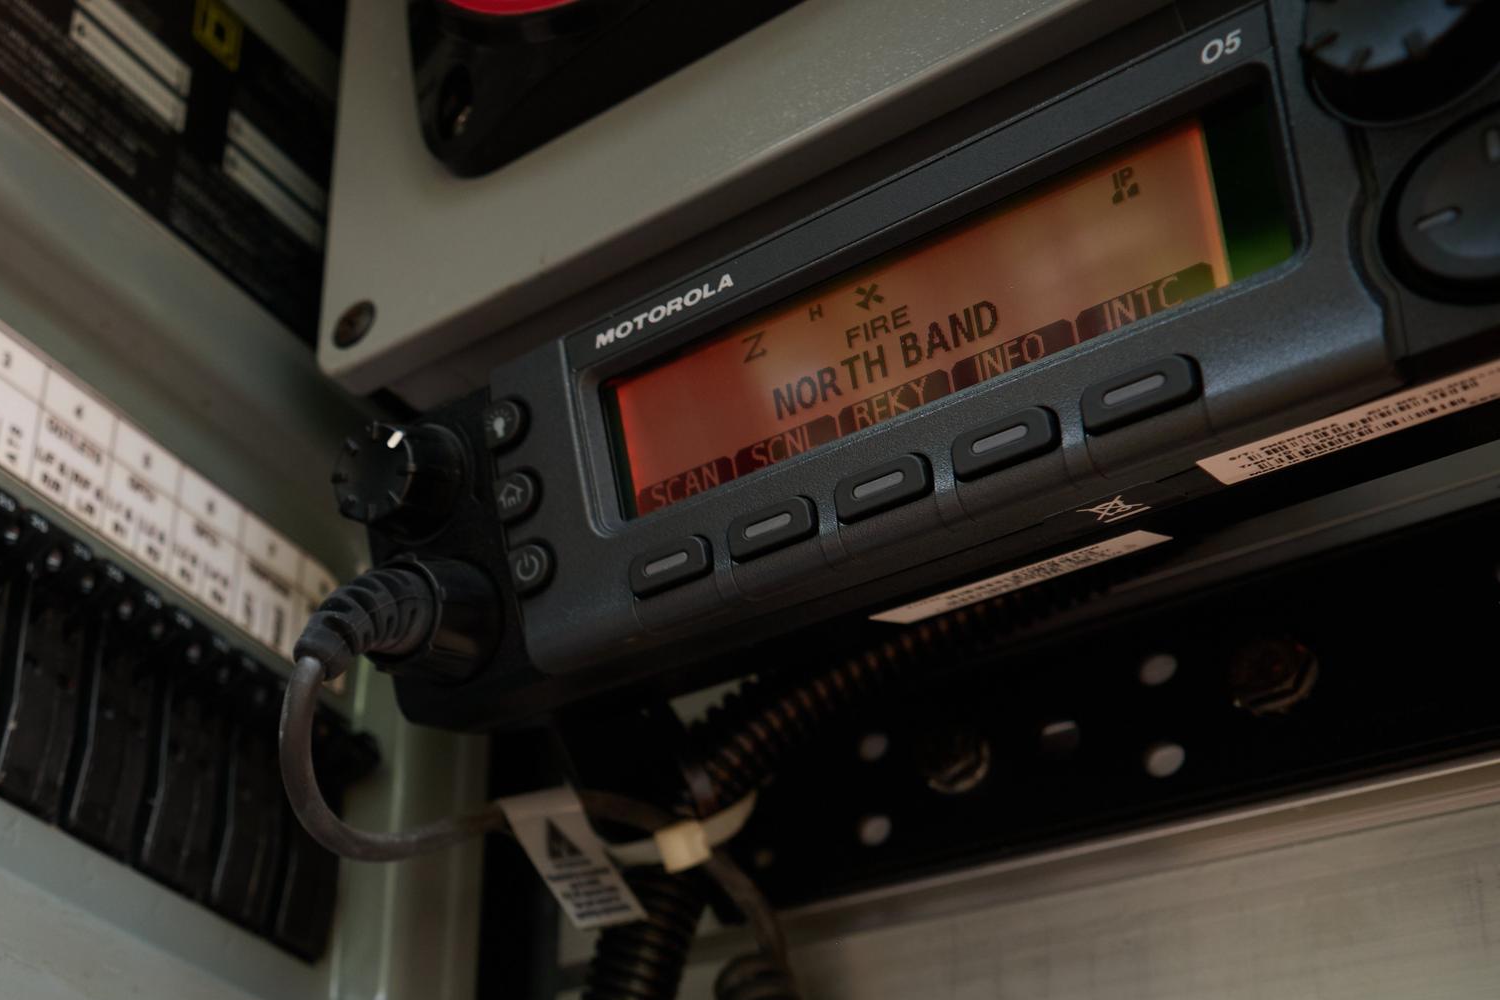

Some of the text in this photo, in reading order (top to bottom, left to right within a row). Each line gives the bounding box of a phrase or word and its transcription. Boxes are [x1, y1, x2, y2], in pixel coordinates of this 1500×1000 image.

[595, 273, 734, 349] MOTOROLA
[1103, 275, 1185, 329] INTC
[742, 331, 768, 365] Z
[845, 306, 912, 349] FIRE
[772, 301, 999, 421] NORTH BAND
[974, 333, 1046, 380] INFO
[650, 464, 719, 508] SCAN
